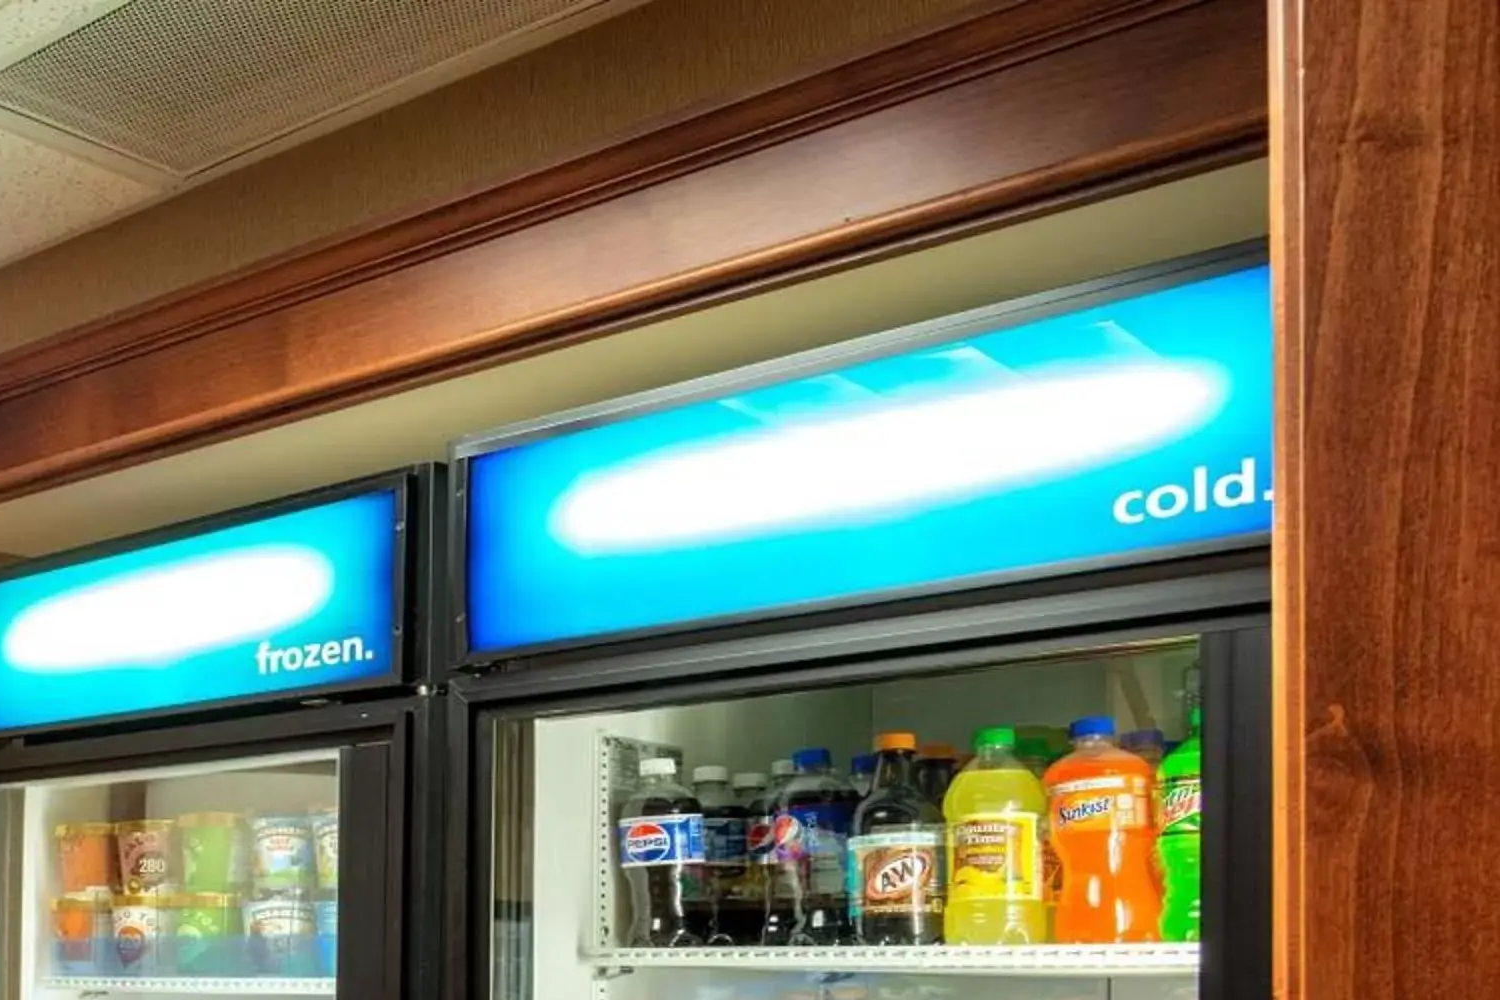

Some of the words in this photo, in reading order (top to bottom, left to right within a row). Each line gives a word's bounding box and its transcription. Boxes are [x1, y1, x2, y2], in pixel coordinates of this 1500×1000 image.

[1112, 456, 1274, 525] cold.
[256, 635, 374, 675] frozen.
[627, 836, 669, 851] PEPSI
